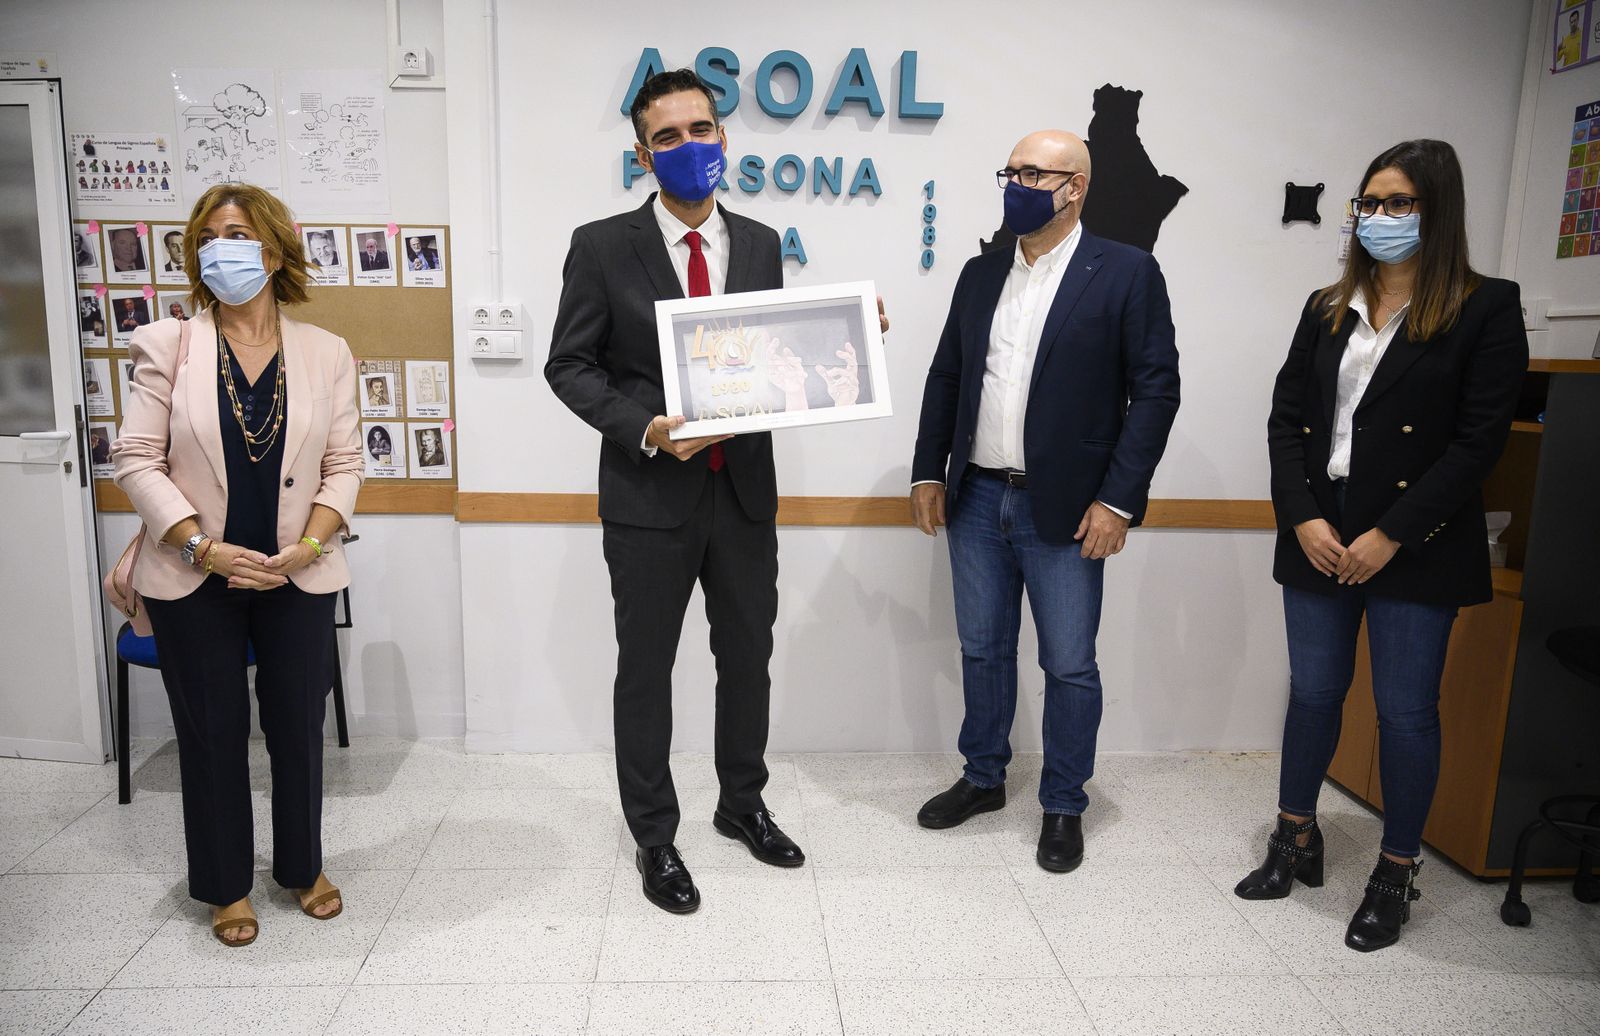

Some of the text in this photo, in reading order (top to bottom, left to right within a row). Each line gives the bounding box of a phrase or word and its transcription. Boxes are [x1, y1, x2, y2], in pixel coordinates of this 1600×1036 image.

[620, 47, 944, 119] ASOAL
[623, 150, 882, 195] PSONA
[921, 180, 937, 269] 1980
